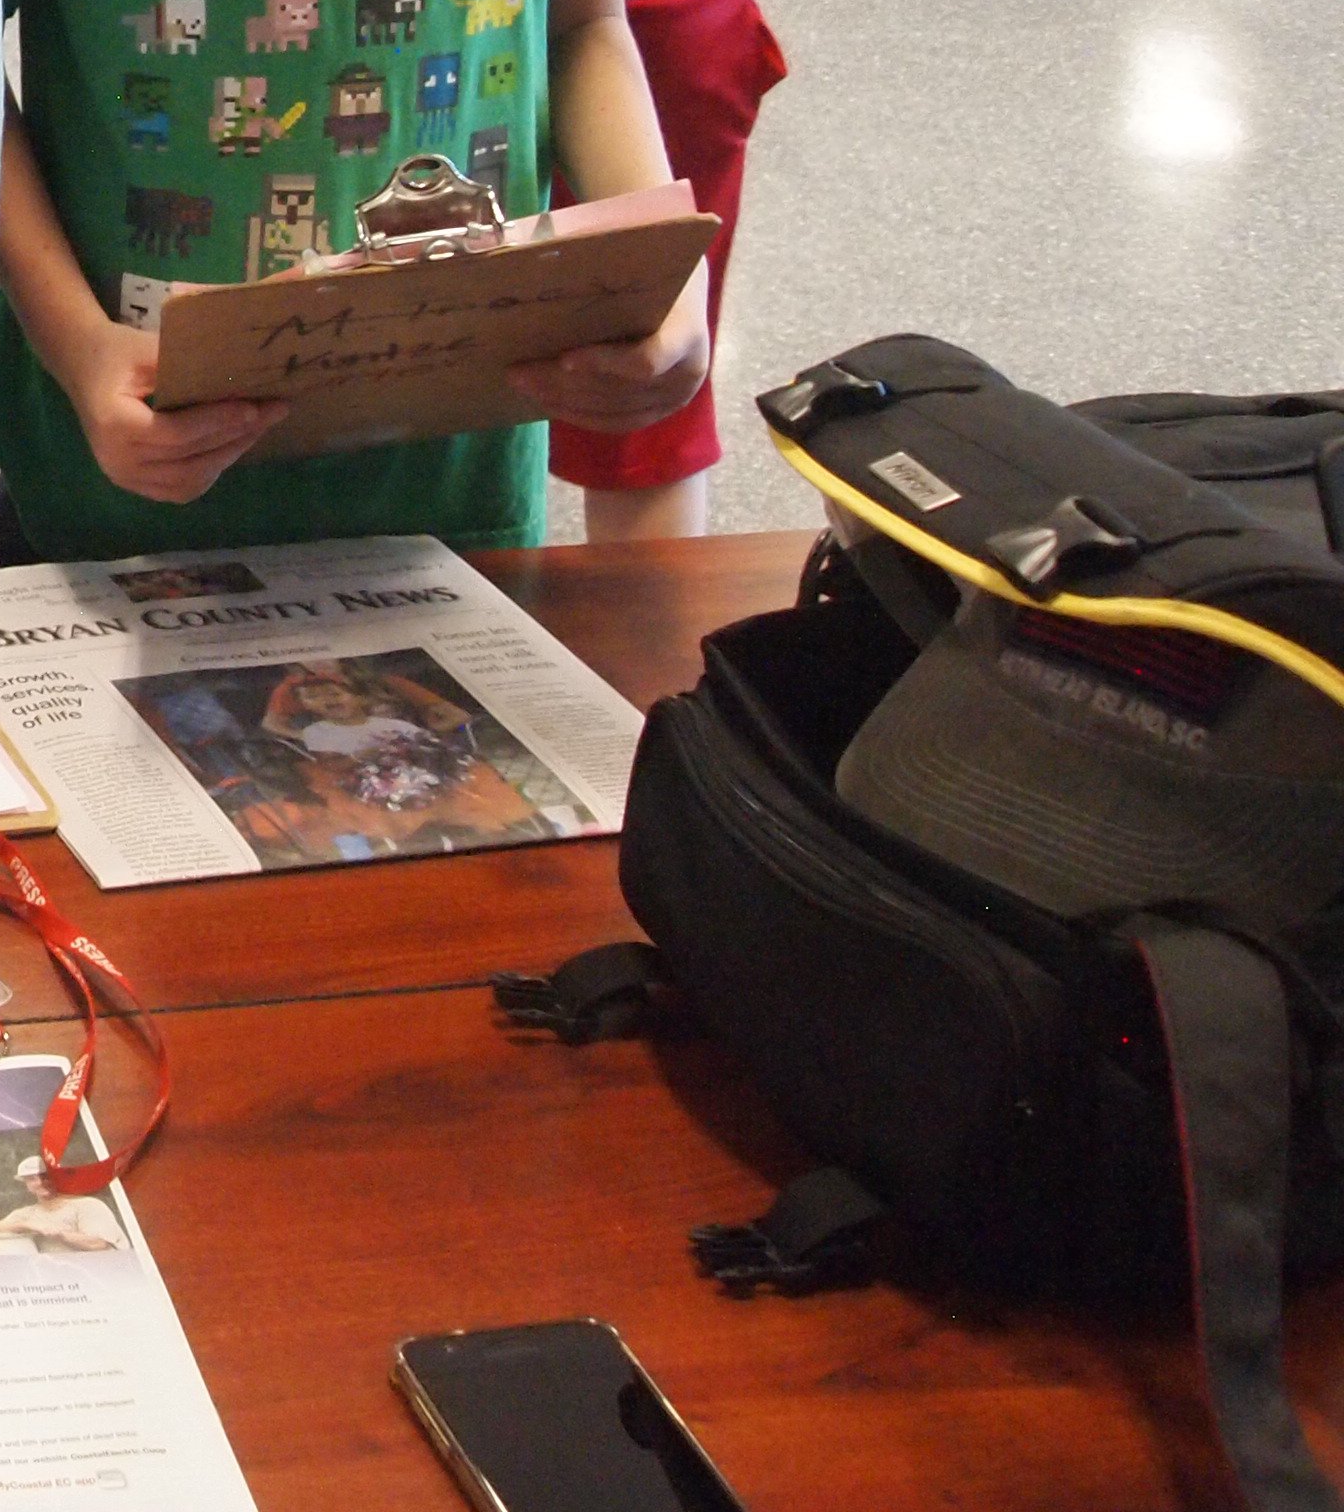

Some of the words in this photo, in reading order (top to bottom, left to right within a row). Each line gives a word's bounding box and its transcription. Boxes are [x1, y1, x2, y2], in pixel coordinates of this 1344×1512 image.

[0, 680, 94, 702] services,
[12, 695, 83, 717] quality
[22, 715, 43, 729] of
[48, 710, 83, 724] life
[9, 856, 46, 906] PRESS
